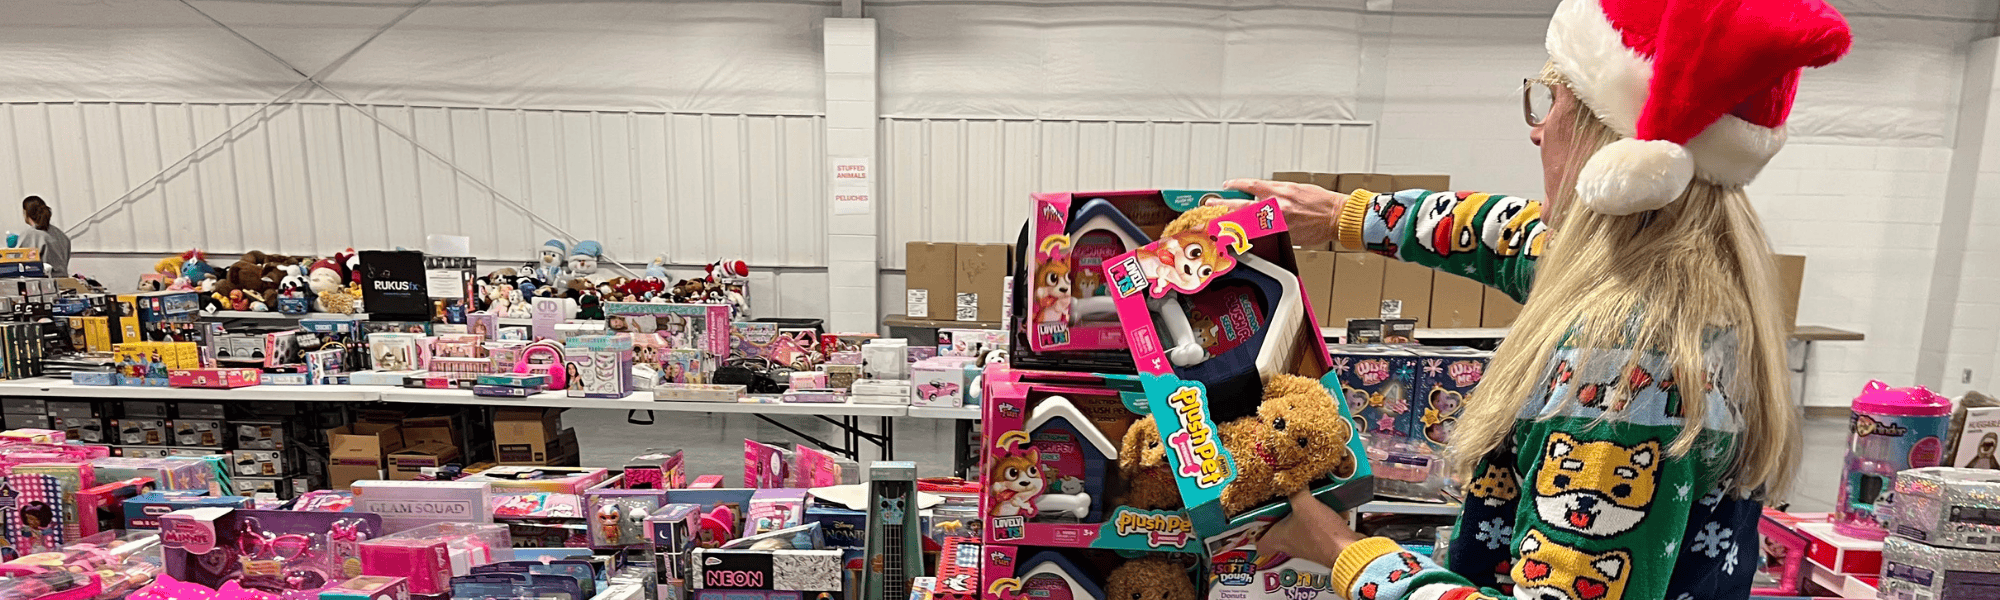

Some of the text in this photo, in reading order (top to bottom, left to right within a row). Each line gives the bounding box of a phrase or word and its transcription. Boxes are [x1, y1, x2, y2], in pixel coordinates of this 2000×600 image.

[1123, 258, 1146, 287] LOVELY
[374, 281, 419, 291] RUKUSfx
[1110, 264, 1137, 296] PETS!
[1225, 292, 1249, 330] PLUSH
[1240, 293, 1260, 334] ELECTRON
[1040, 324, 1067, 335] LOVELY
[1221, 315, 1236, 339] SERIES
[1152, 358, 1161, 370] 3+
[1171, 389, 1221, 485] Plush Pet
[370, 504, 464, 514] GLAM SQUAD
[833, 521, 854, 529] Disney
[995, 518, 1021, 528] LOVELY
[1118, 513, 1191, 533] Plush Pe
[821, 528, 865, 540] NCANT
[995, 526, 1024, 540] PETS!
[1215, 563, 1257, 574] SOFTEE
[706, 570, 763, 587] NEON
[1220, 573, 1253, 583] Dough
[1287, 587, 1317, 600] Shop
